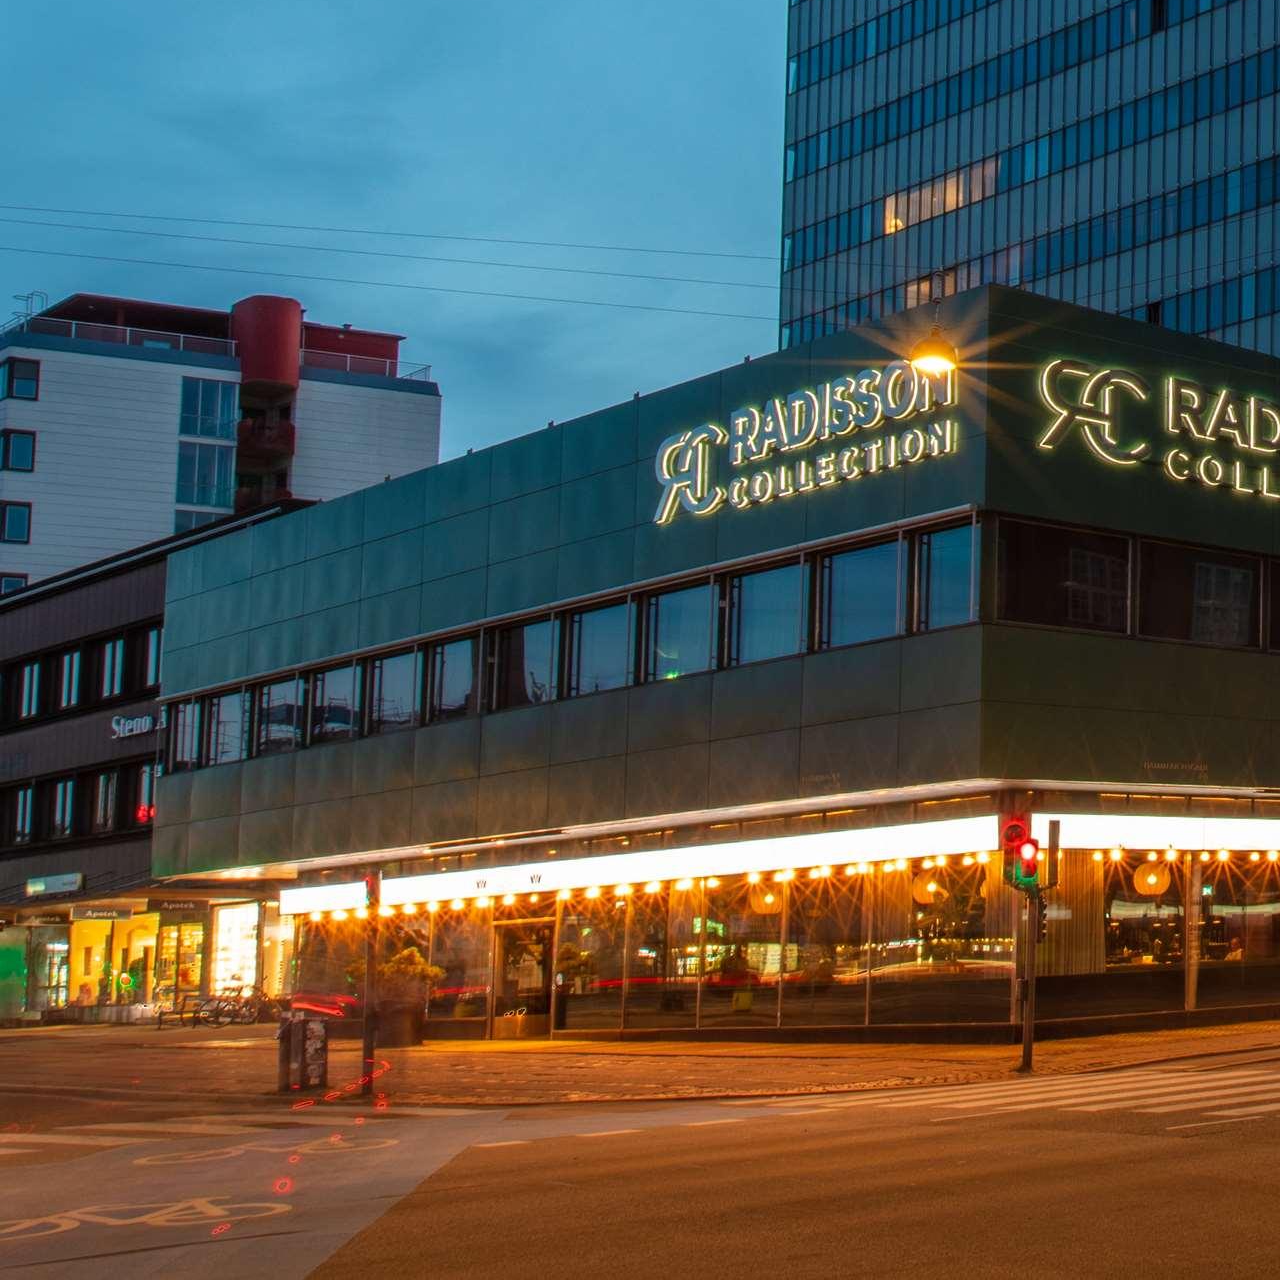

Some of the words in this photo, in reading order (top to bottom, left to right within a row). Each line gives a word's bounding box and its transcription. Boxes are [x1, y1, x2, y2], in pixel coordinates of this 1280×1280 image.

[729, 360, 959, 466] RADISSON
[728, 419, 958, 508] COLLECTION
[111, 714, 152, 739] Steno
[85, 909, 118, 918] Apotek
[161, 902, 195, 910] Apotek
